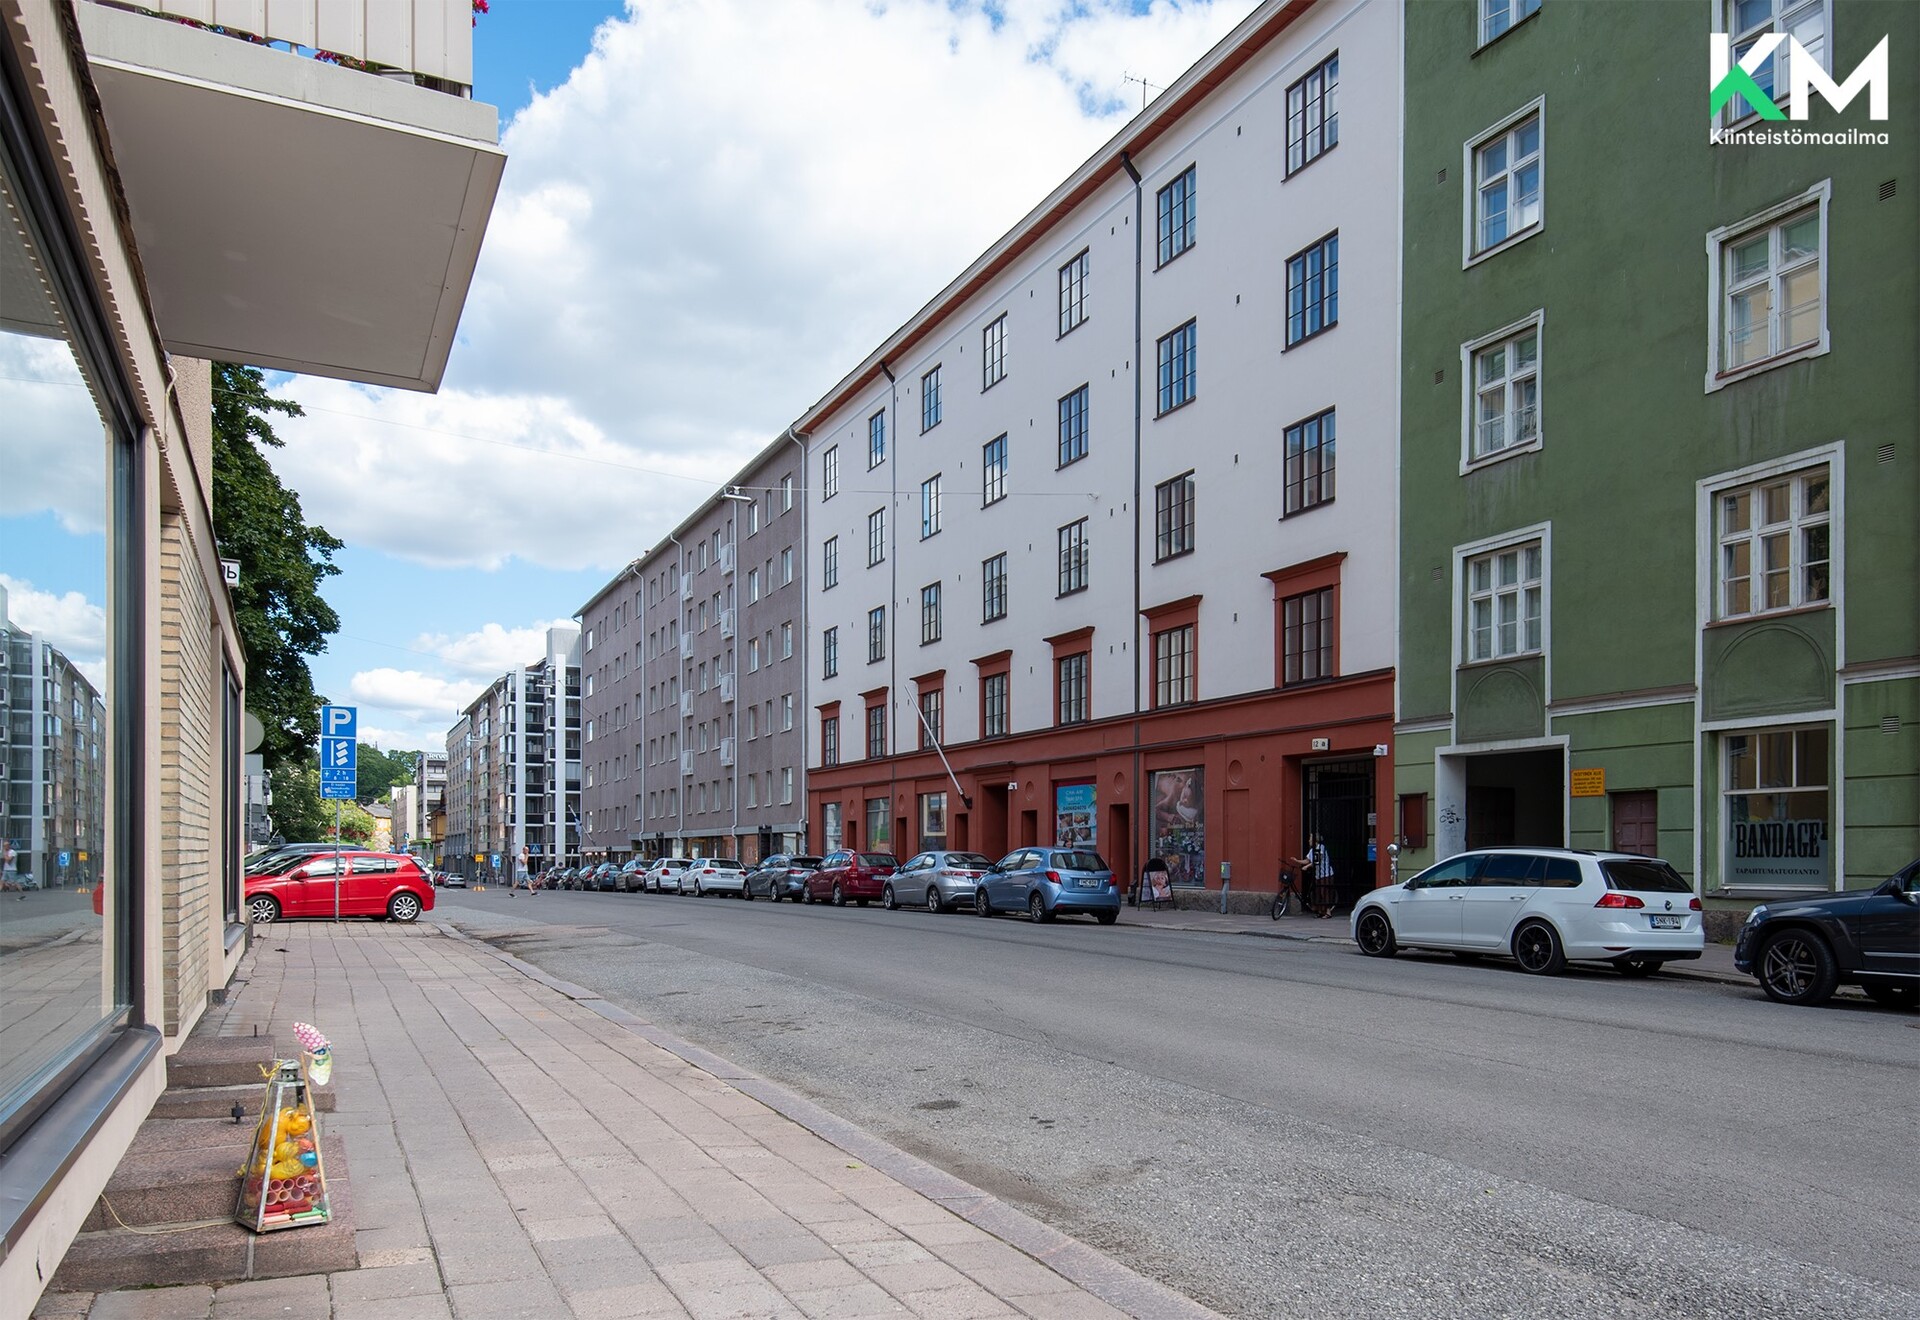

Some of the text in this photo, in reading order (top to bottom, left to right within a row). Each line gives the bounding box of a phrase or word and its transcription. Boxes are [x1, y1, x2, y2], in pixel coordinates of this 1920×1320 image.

[329, 708, 352, 735] P
[1735, 822, 1820, 858] BANDAGE
[1735, 867, 1820, 876] TAPAHTUMATUOTANTO
